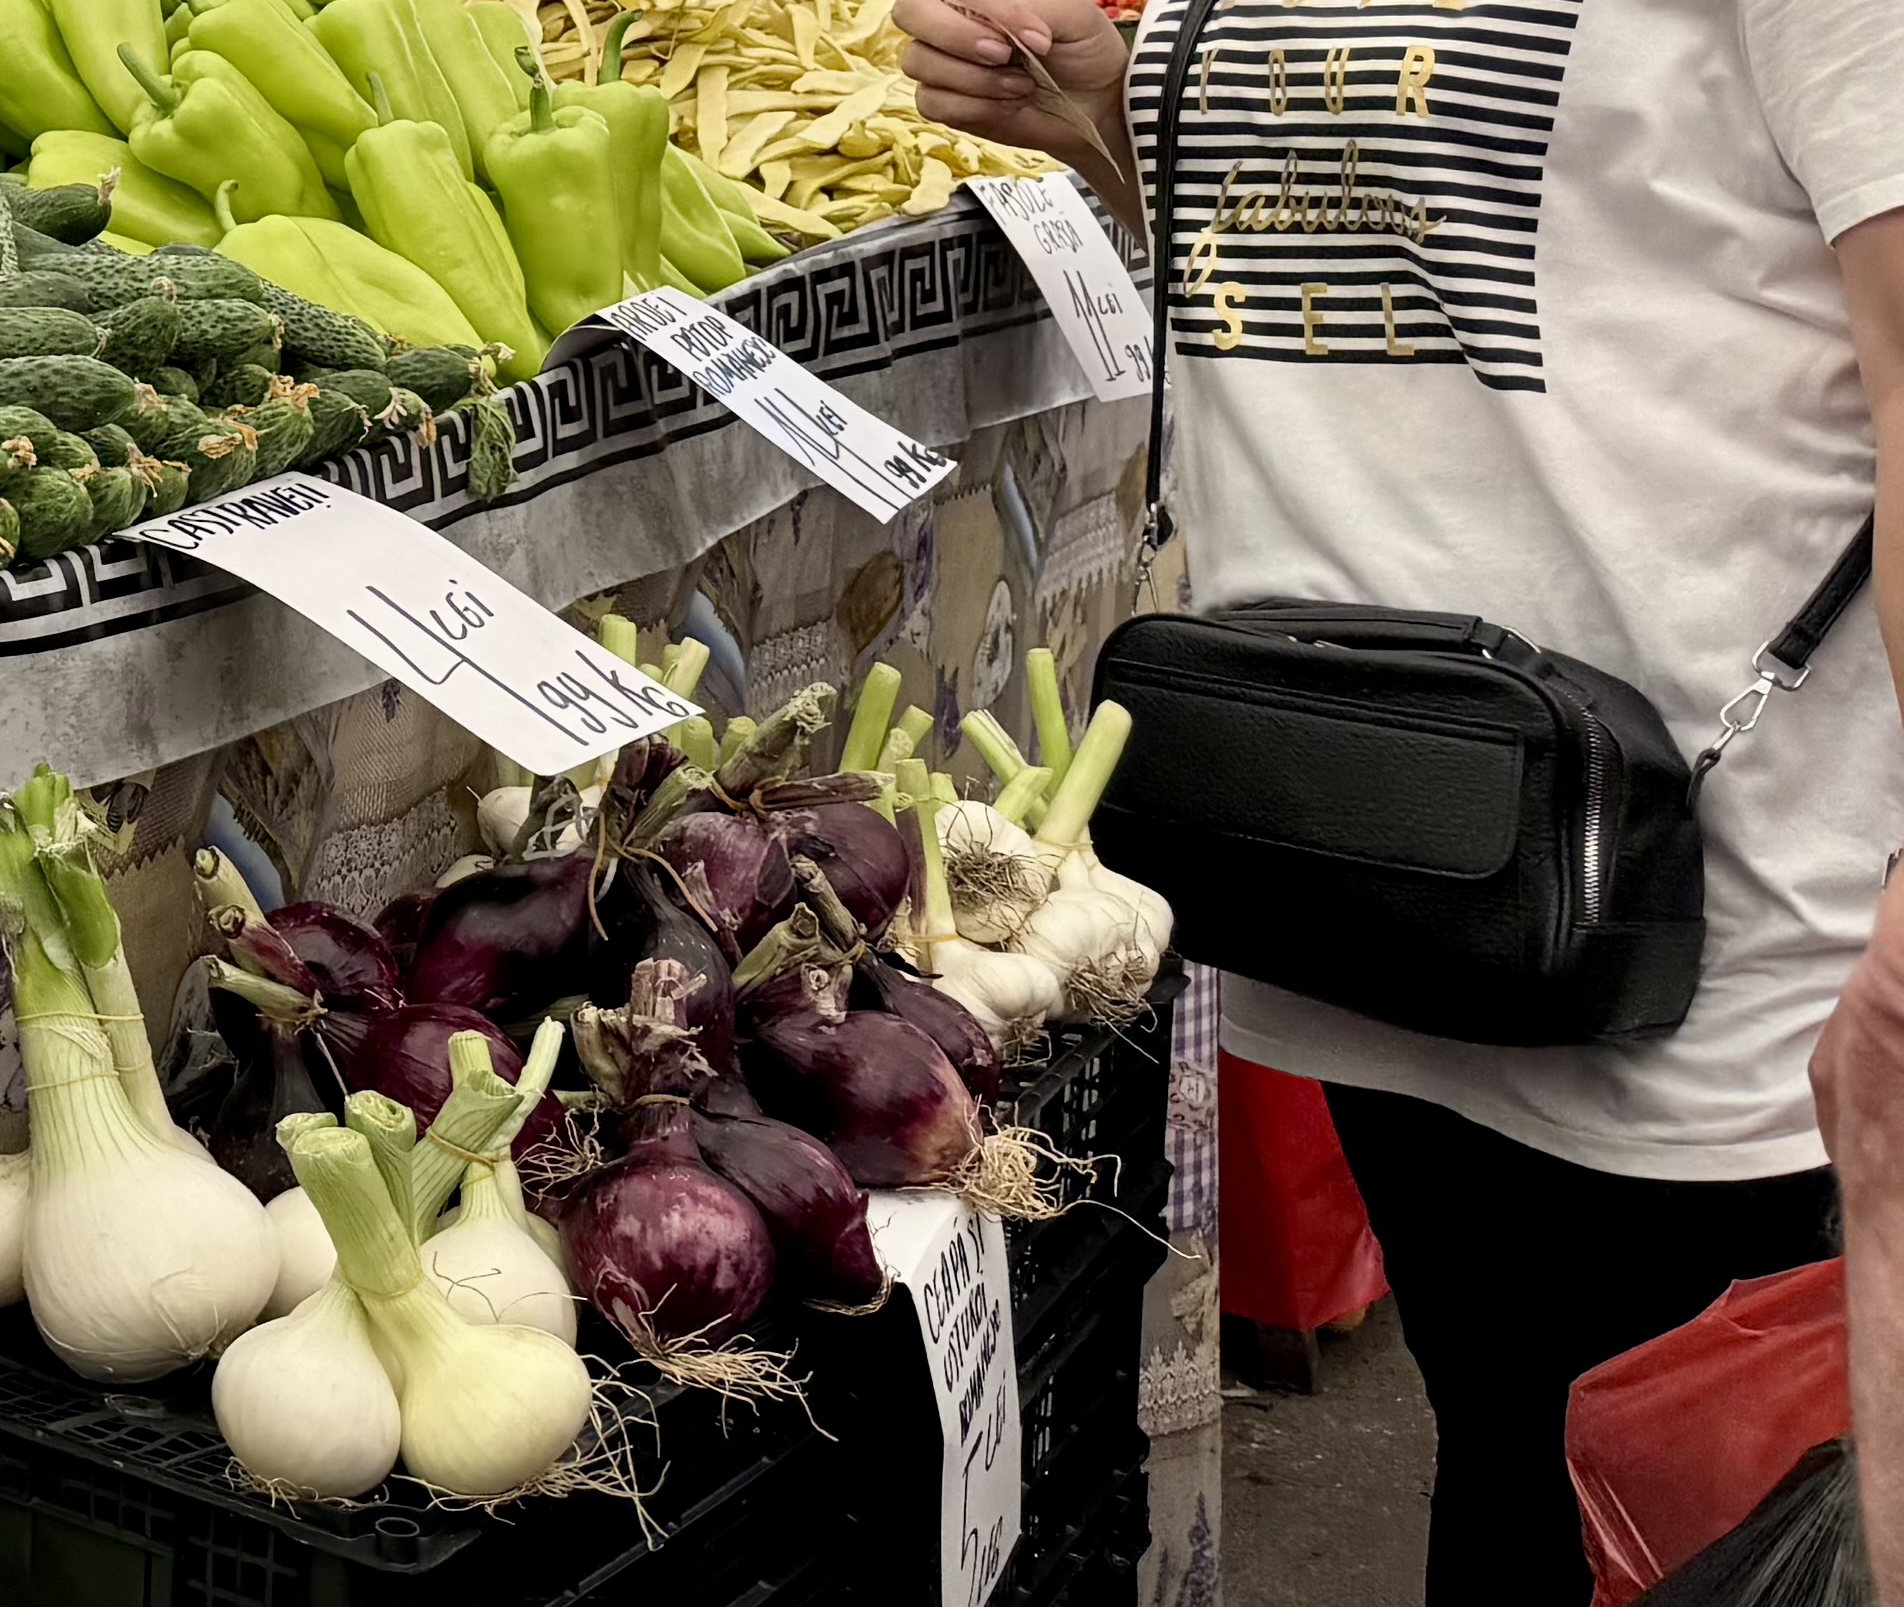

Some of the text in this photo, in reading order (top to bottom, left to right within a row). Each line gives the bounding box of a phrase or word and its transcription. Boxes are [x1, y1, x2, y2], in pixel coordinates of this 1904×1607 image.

[1197, 44, 1436, 118] YOUR
[1183, 139, 1447, 298] fabulous
[609, 291, 688, 342] ARDEI
[1211, 281, 1417, 356] SEL
